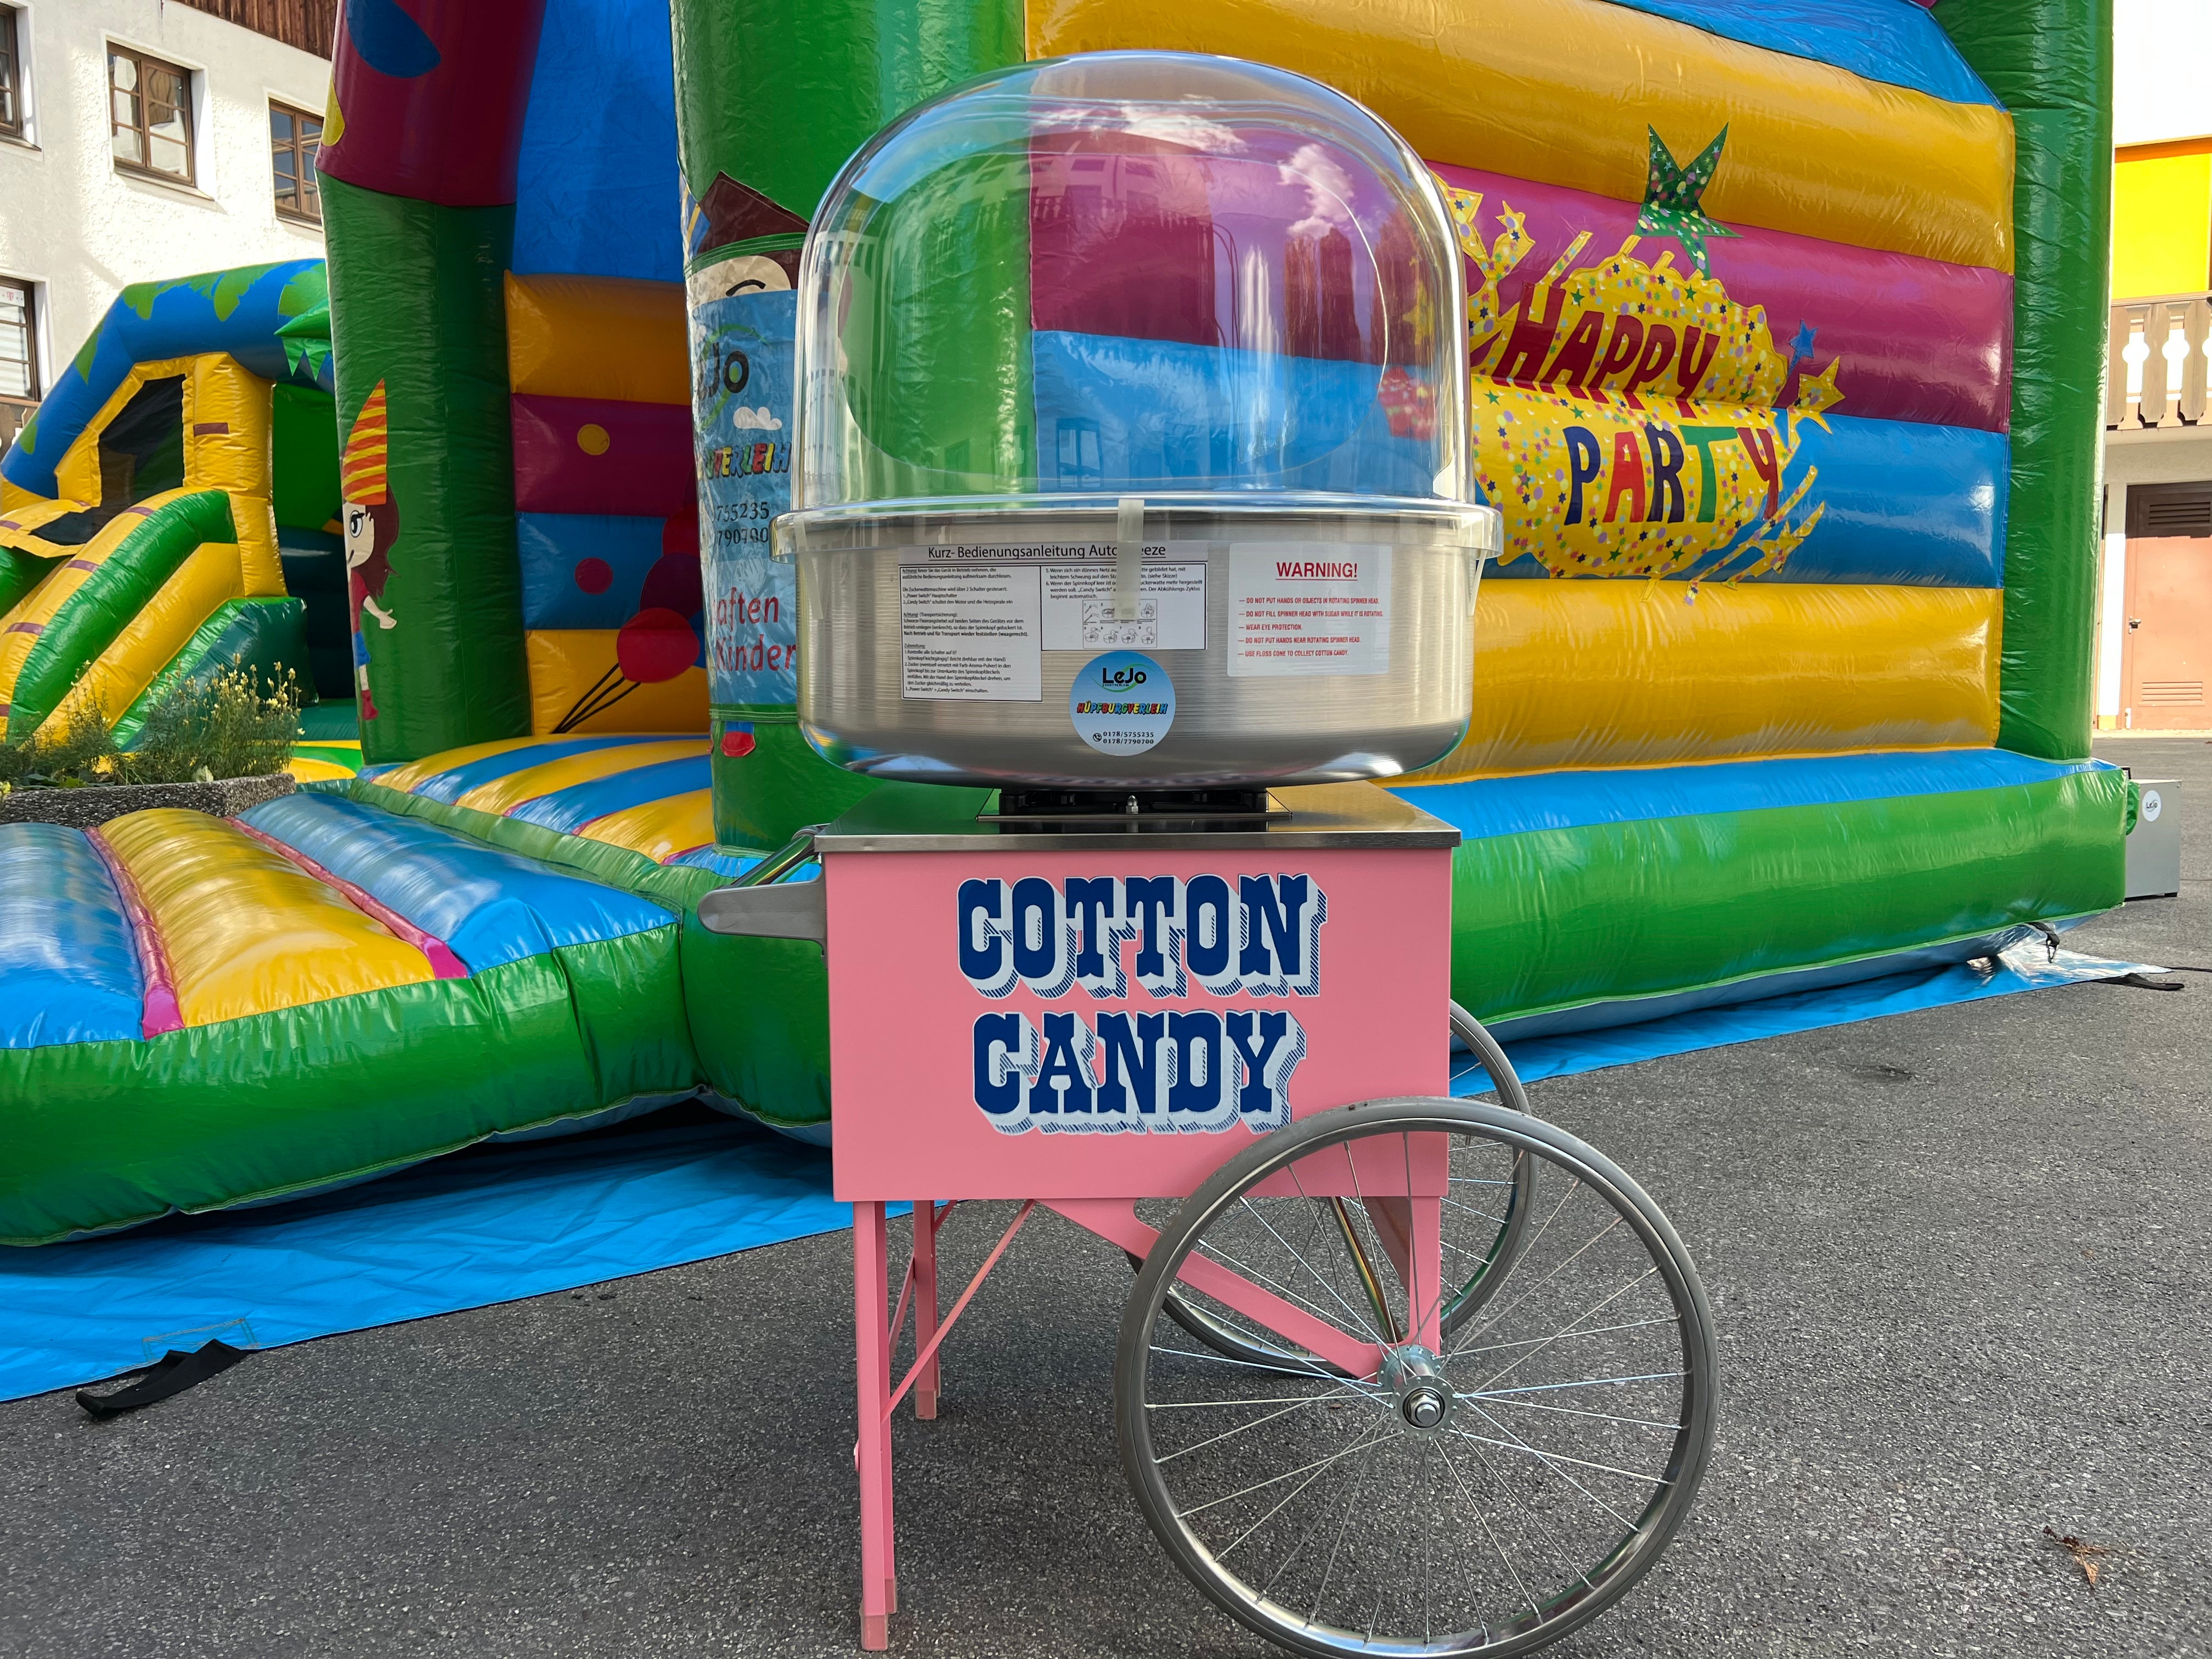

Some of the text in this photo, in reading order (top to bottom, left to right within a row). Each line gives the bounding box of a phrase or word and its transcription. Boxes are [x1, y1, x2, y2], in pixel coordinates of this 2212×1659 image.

[1491, 280, 1720, 419] HAPPY
[1562, 423, 1779, 525] PARTY
[715, 501, 769, 522] 755235
[716, 528, 769, 546] 790700
[928, 547, 955, 558] Kurz-
[958, 545, 1085, 560] Bedienungsanleitung
[1276, 562, 1358, 578] WARNING!
[715, 634, 797, 672] Kinder
[1102, 668, 1147, 684] LeJo
[1077, 701, 1168, 715] HÜPFBURGVERLEIH
[957, 873, 1327, 998] COTTON
[973, 1009, 1306, 1135] CANDY
